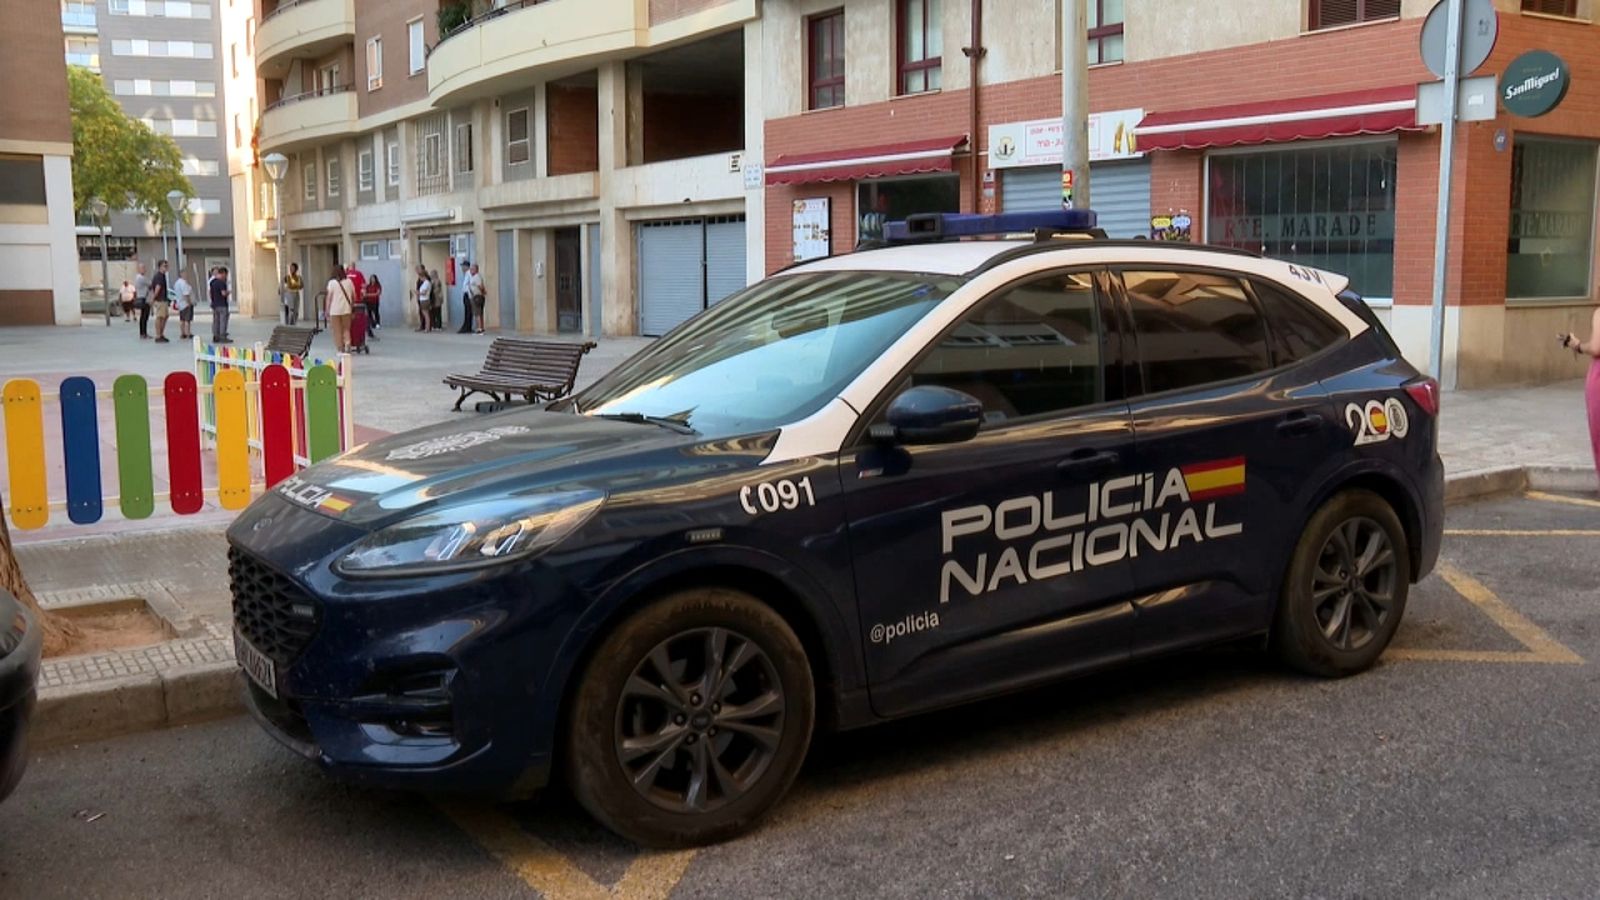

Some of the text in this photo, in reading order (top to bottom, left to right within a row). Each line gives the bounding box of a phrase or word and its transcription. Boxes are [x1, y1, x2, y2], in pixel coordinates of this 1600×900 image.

[1281, 214, 1376, 237] MARADE
[1345, 397, 1408, 446] 200
[758, 476, 816, 513] 091
[940, 502, 1242, 603] NACIONAL
[870, 610, 940, 643] @policia
